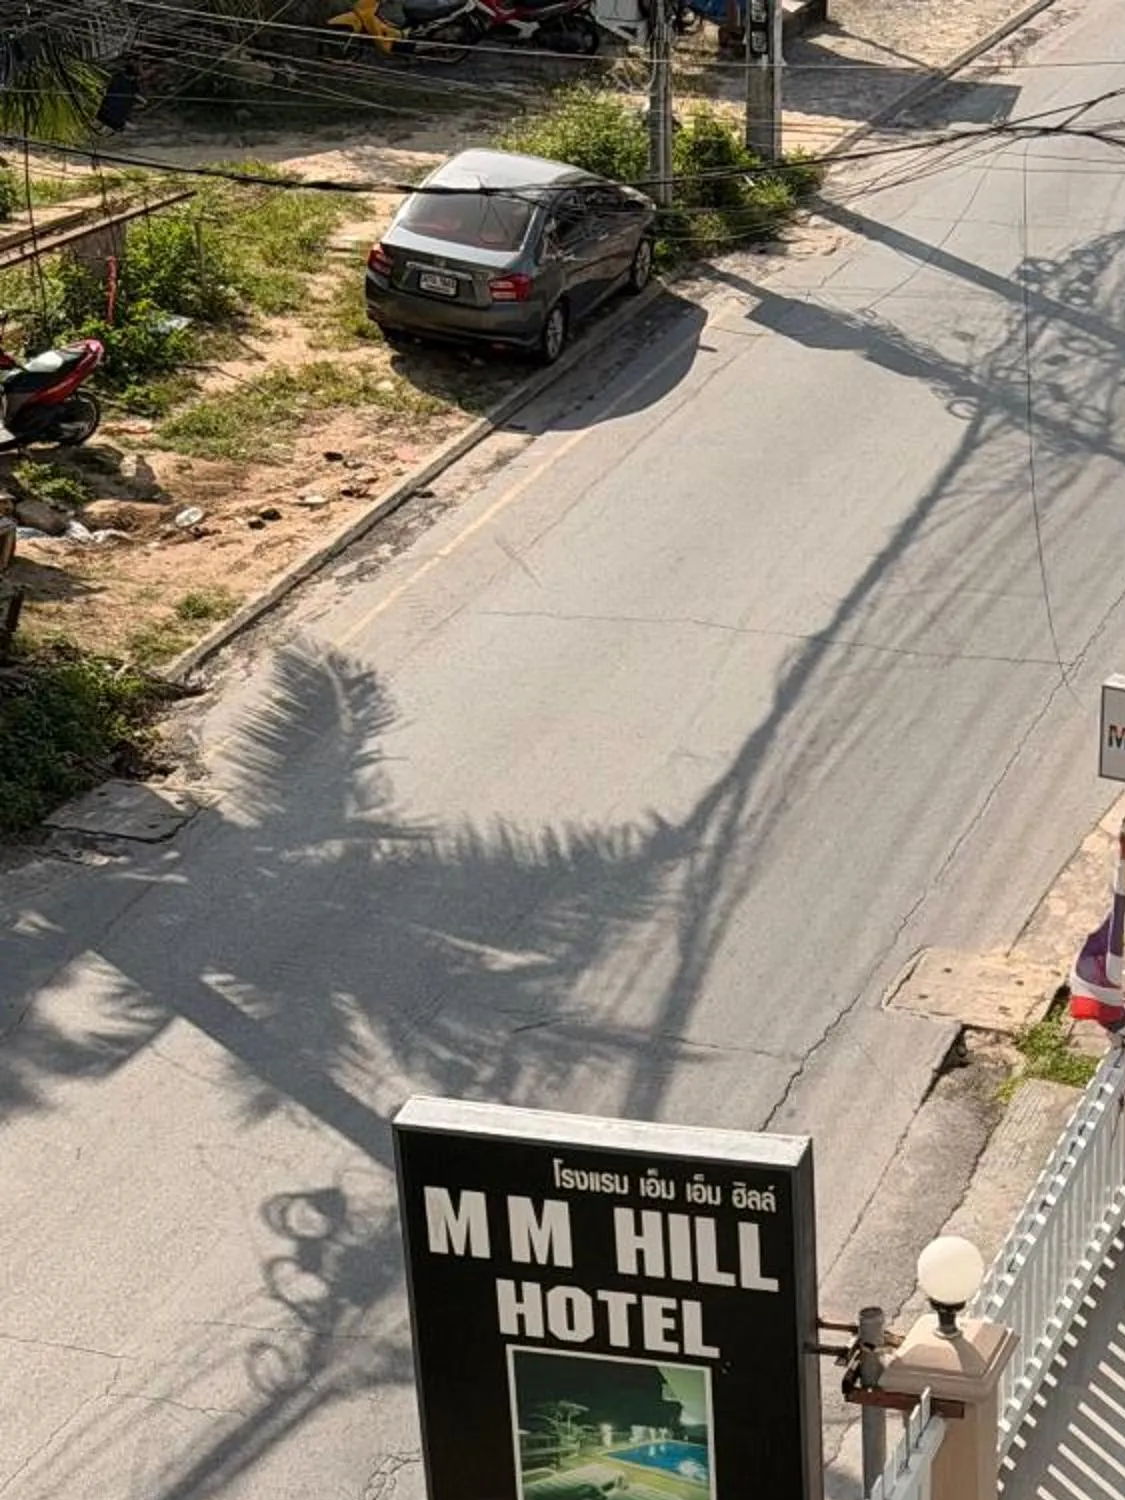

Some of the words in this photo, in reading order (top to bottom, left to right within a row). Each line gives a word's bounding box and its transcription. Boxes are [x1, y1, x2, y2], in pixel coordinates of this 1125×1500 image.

[552, 1157, 630, 1195] โรงแรม
[639, 1167, 676, 1200] เอ็ม
[685, 1173, 722, 1206] เอ็ม
[731, 1180, 777, 1213] ฮิลล์
[613, 1206, 780, 1293] HILL
[495, 1277, 721, 1359] HOTEL
